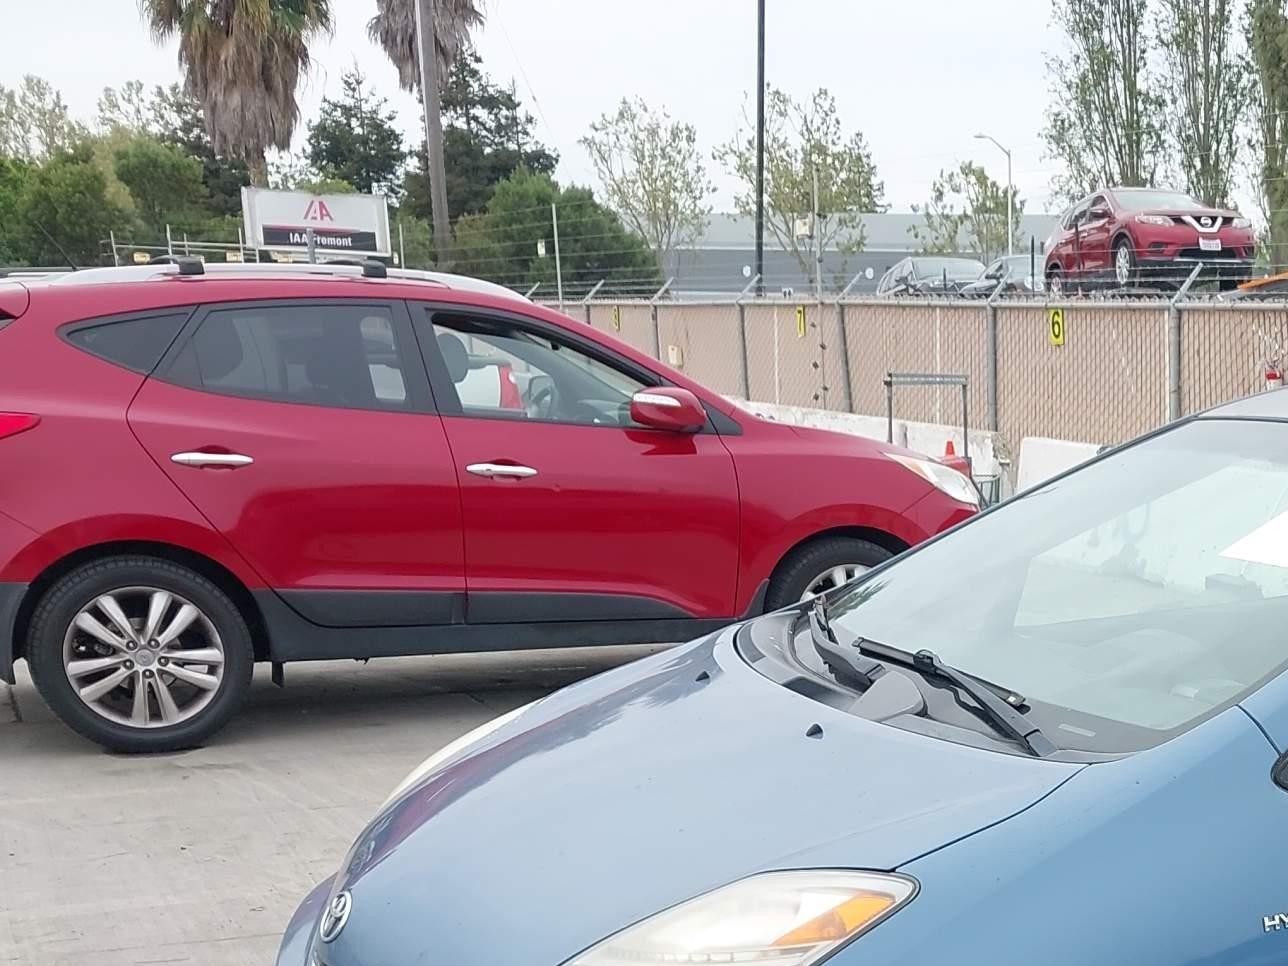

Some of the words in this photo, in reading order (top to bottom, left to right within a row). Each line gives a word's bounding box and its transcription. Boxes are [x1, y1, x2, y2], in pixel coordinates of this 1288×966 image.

[289, 231, 308, 244] IAA
[313, 232, 353, 247] remont
[1051, 311, 1061, 339] 6
